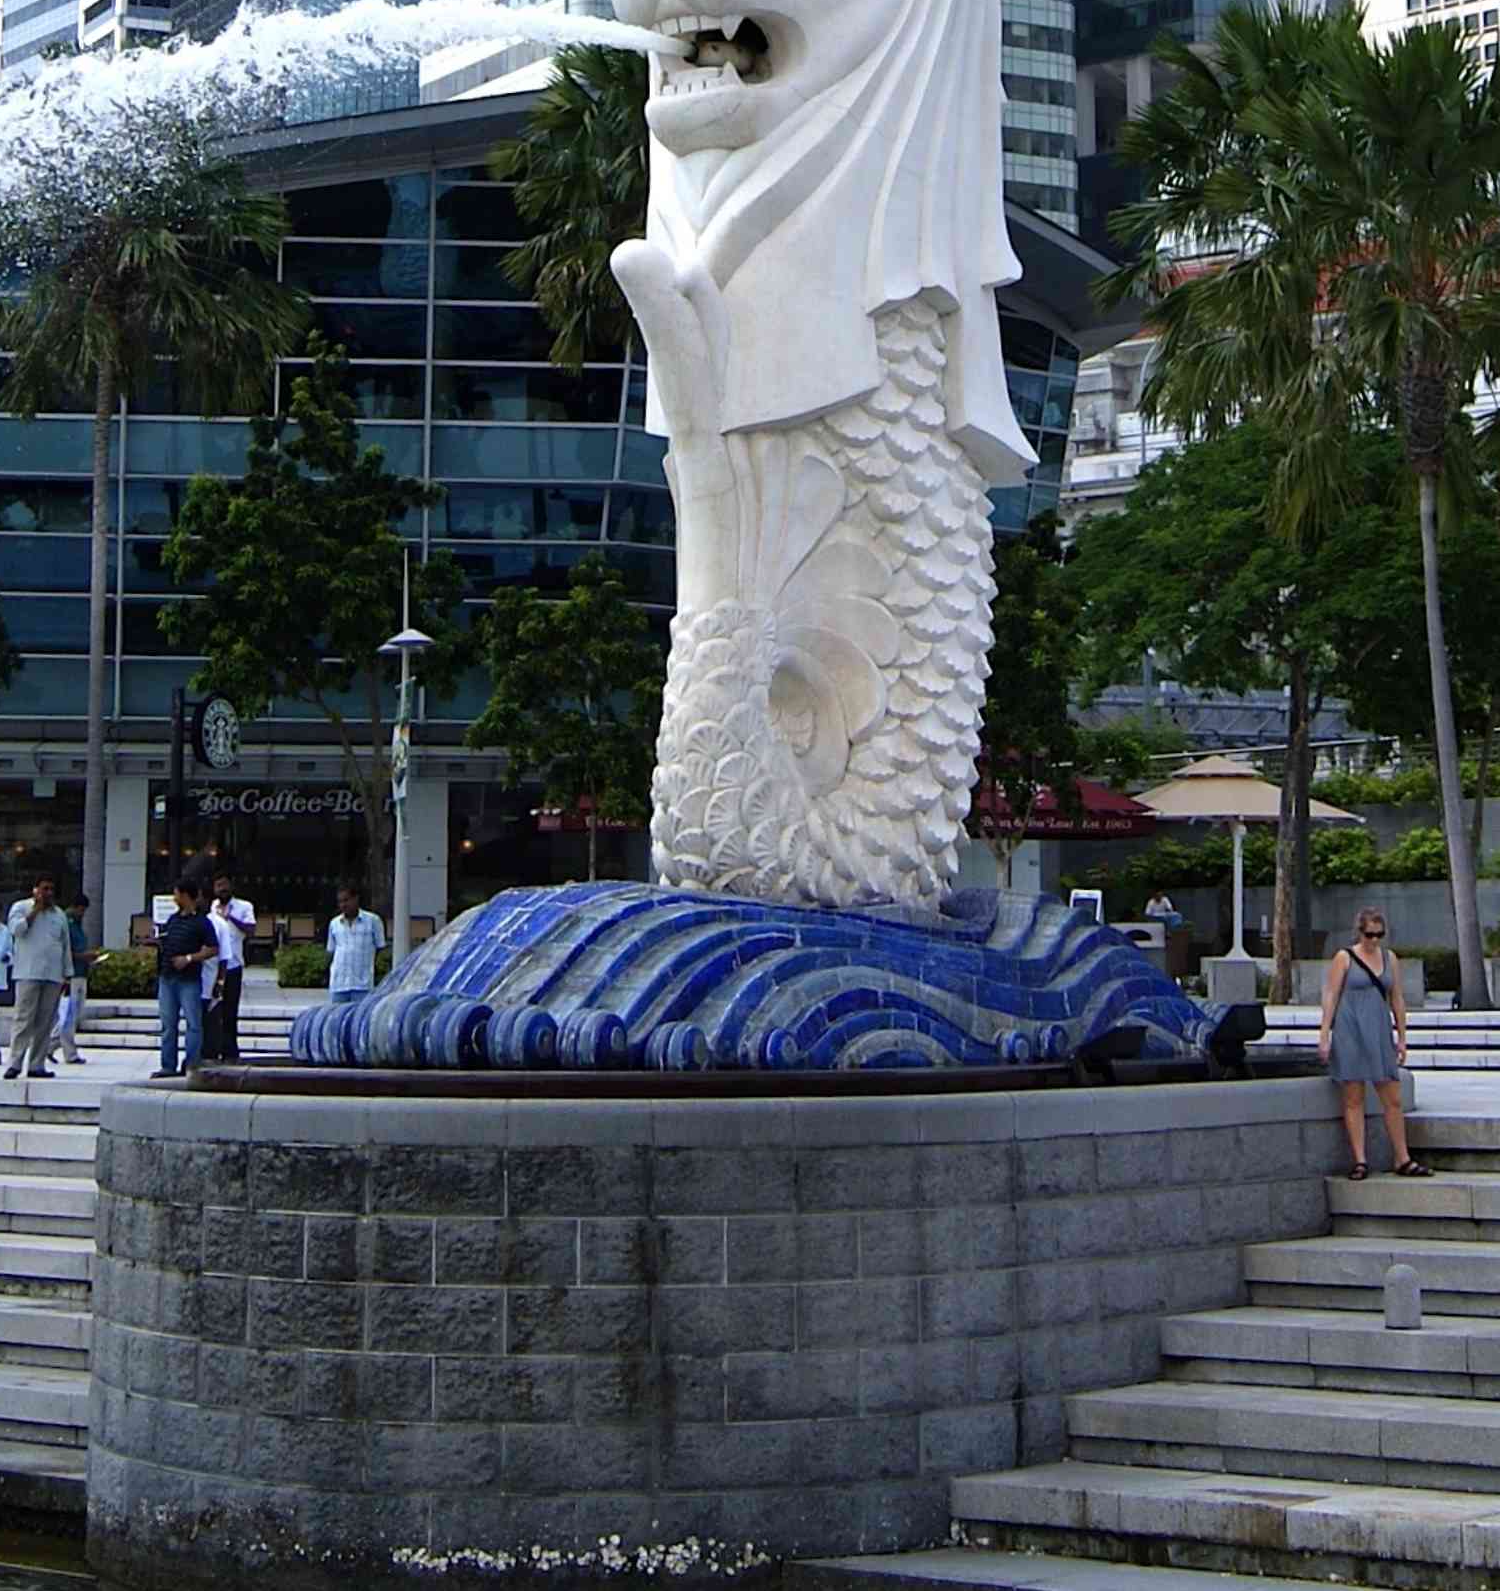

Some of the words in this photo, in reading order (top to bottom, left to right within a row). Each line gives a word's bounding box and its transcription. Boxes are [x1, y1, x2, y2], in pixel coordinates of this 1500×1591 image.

[188, 781, 235, 816] The
[239, 788, 322, 814] Coffee
[323, 788, 397, 812] Ben
